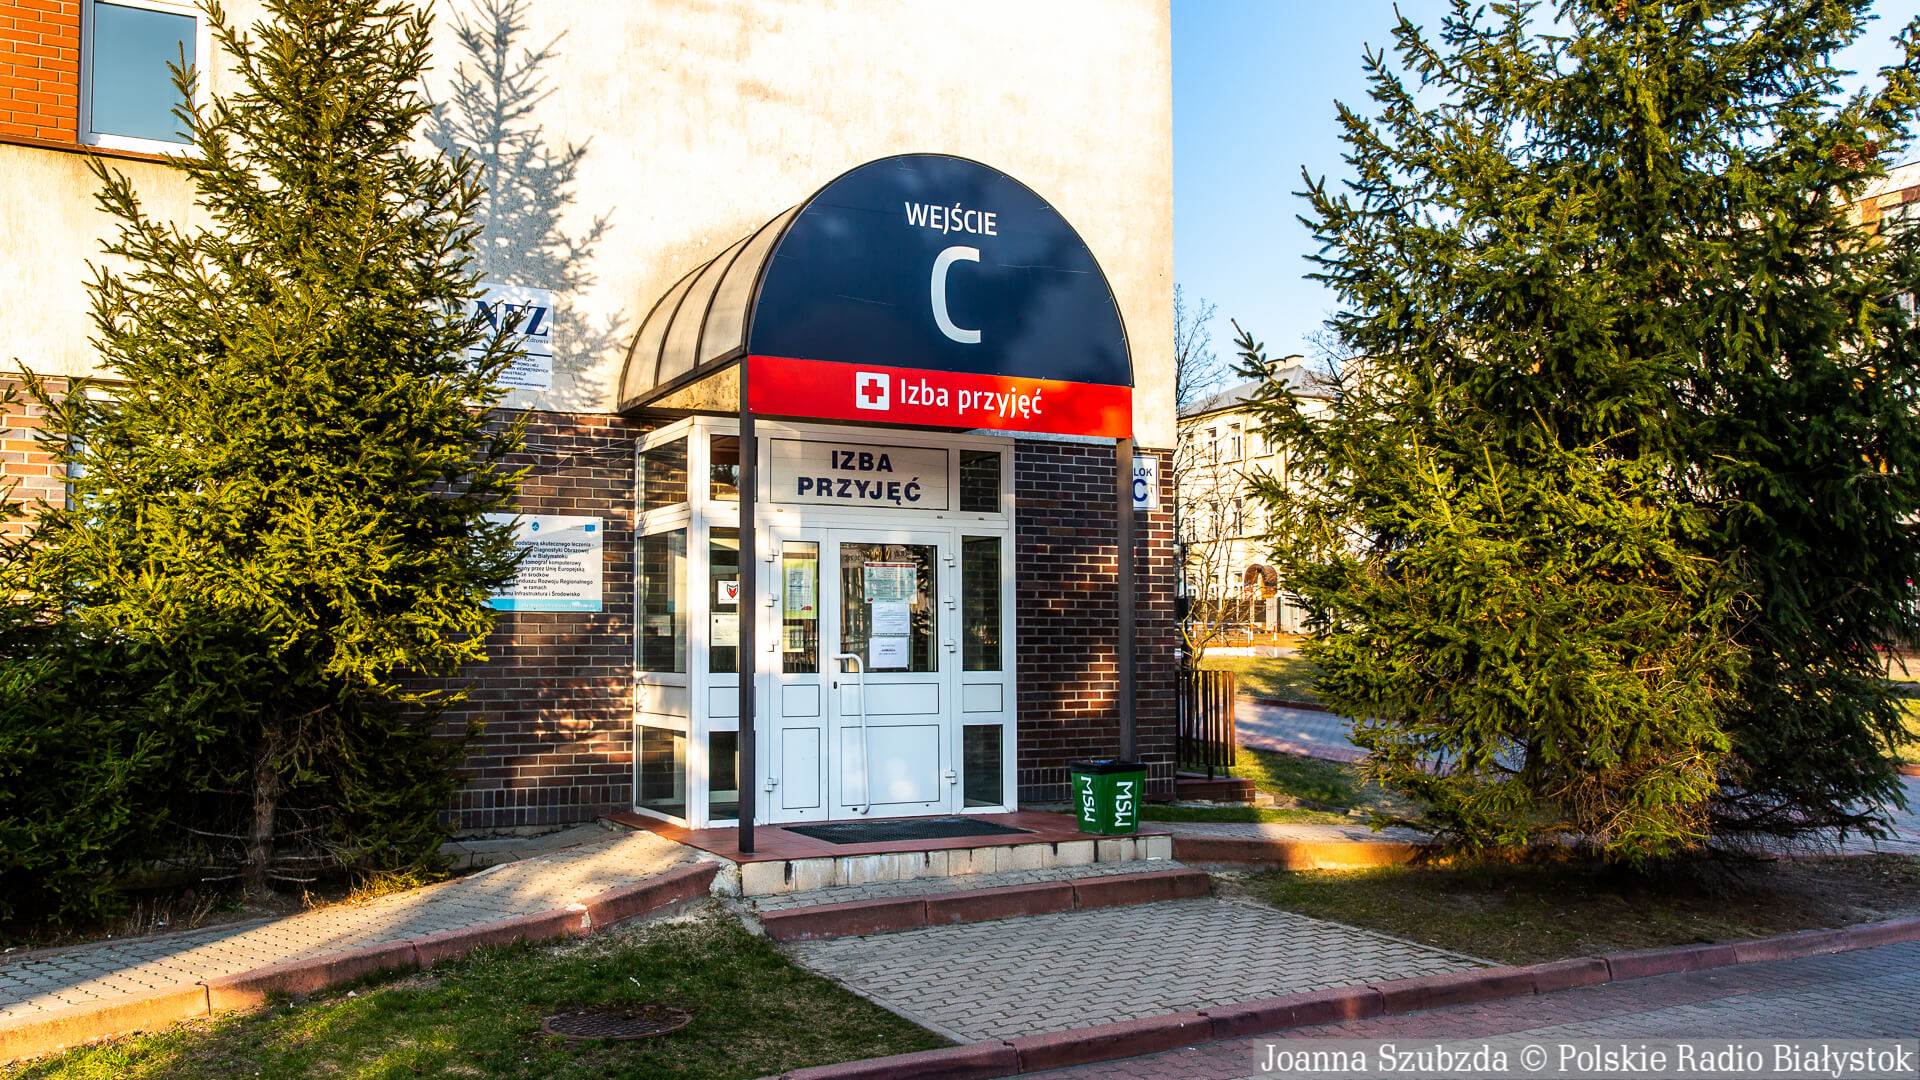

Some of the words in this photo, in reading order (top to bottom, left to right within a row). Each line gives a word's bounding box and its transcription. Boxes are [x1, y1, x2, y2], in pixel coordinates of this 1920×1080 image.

[905, 201, 998, 236] WEJŚCIE
[930, 246, 982, 344] C
[900, 378, 948, 407] Izba
[958, 387, 1042, 419] przyjęć
[831, 450, 893, 472] IZBA
[1133, 467, 1153, 477] LOK
[797, 476, 921, 505] PRZYJĘĆ
[1132, 478, 1148, 502] C
[1081, 776, 1096, 822] MSW
[1115, 782, 1133, 826] MSW
